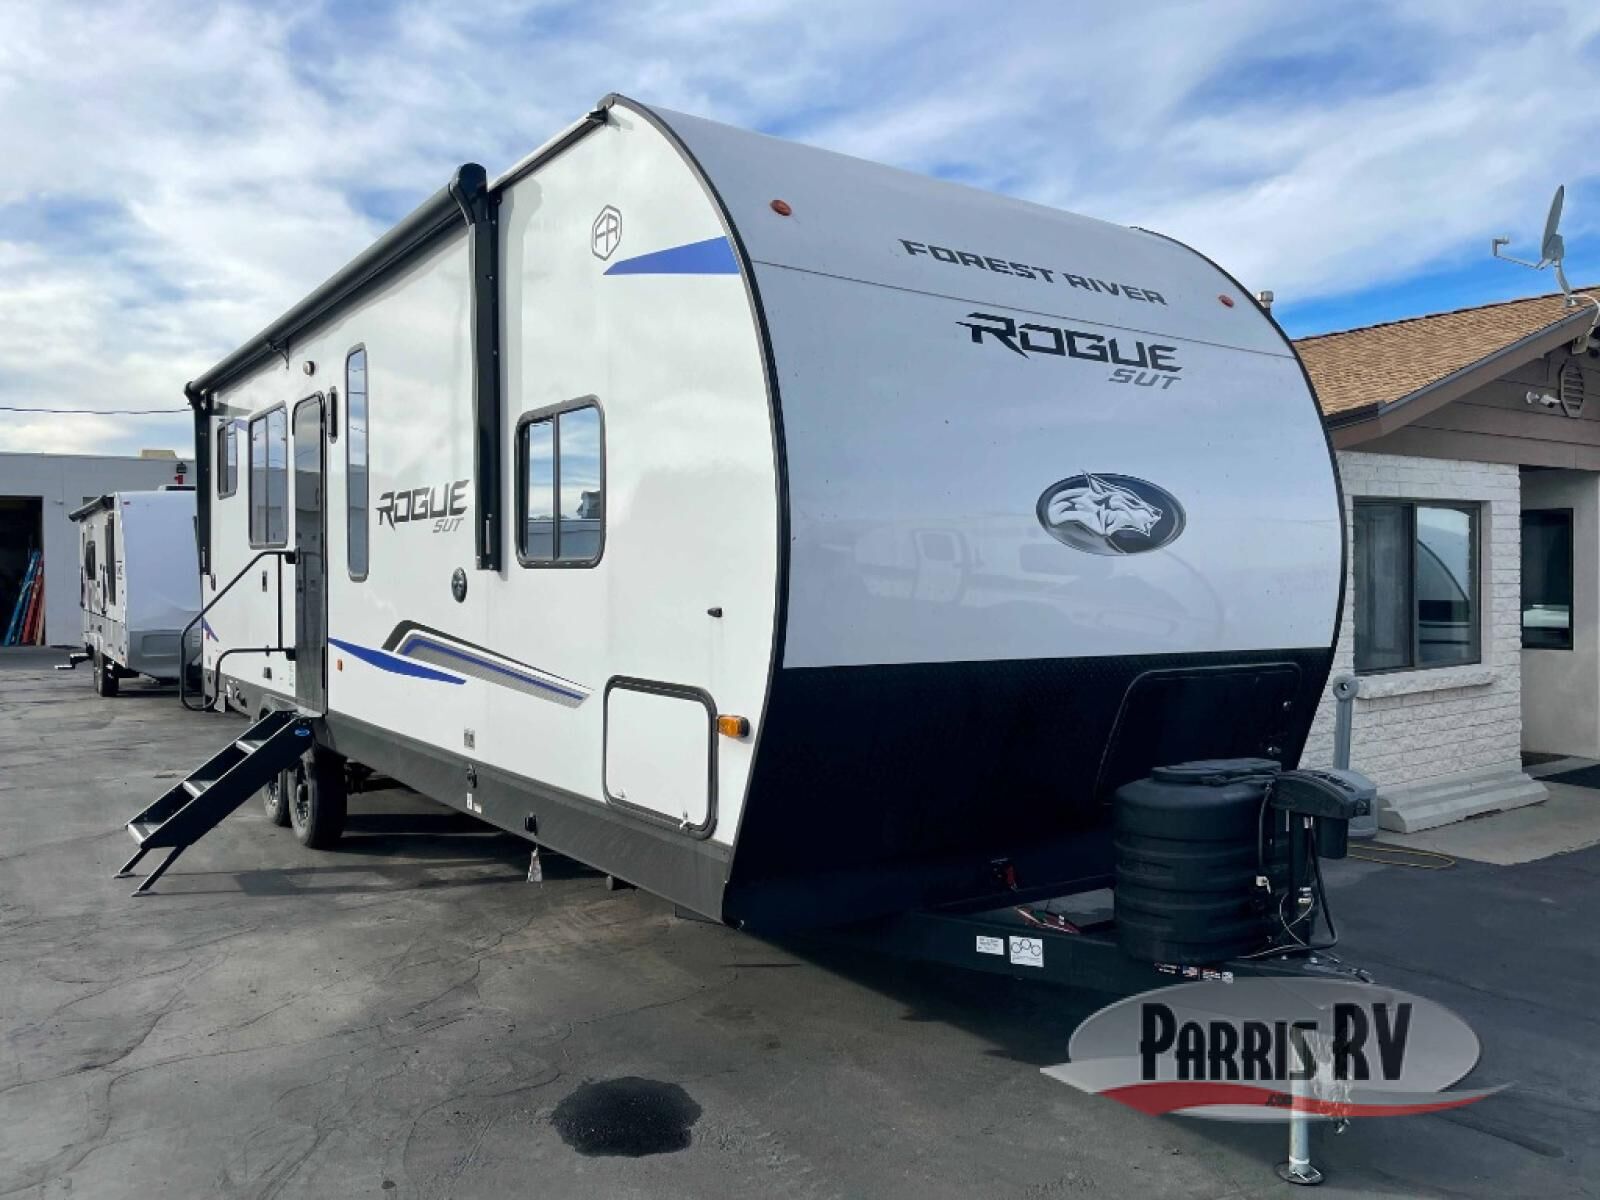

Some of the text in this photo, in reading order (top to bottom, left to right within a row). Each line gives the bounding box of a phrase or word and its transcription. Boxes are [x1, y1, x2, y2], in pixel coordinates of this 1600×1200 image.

[898, 239, 1168, 305] FOREST RIVER
[956, 312, 1183, 372] ROGUE
[1108, 368, 1182, 389] SUT
[376, 480, 470, 531] ROGUE
[432, 517, 464, 533] SUT
